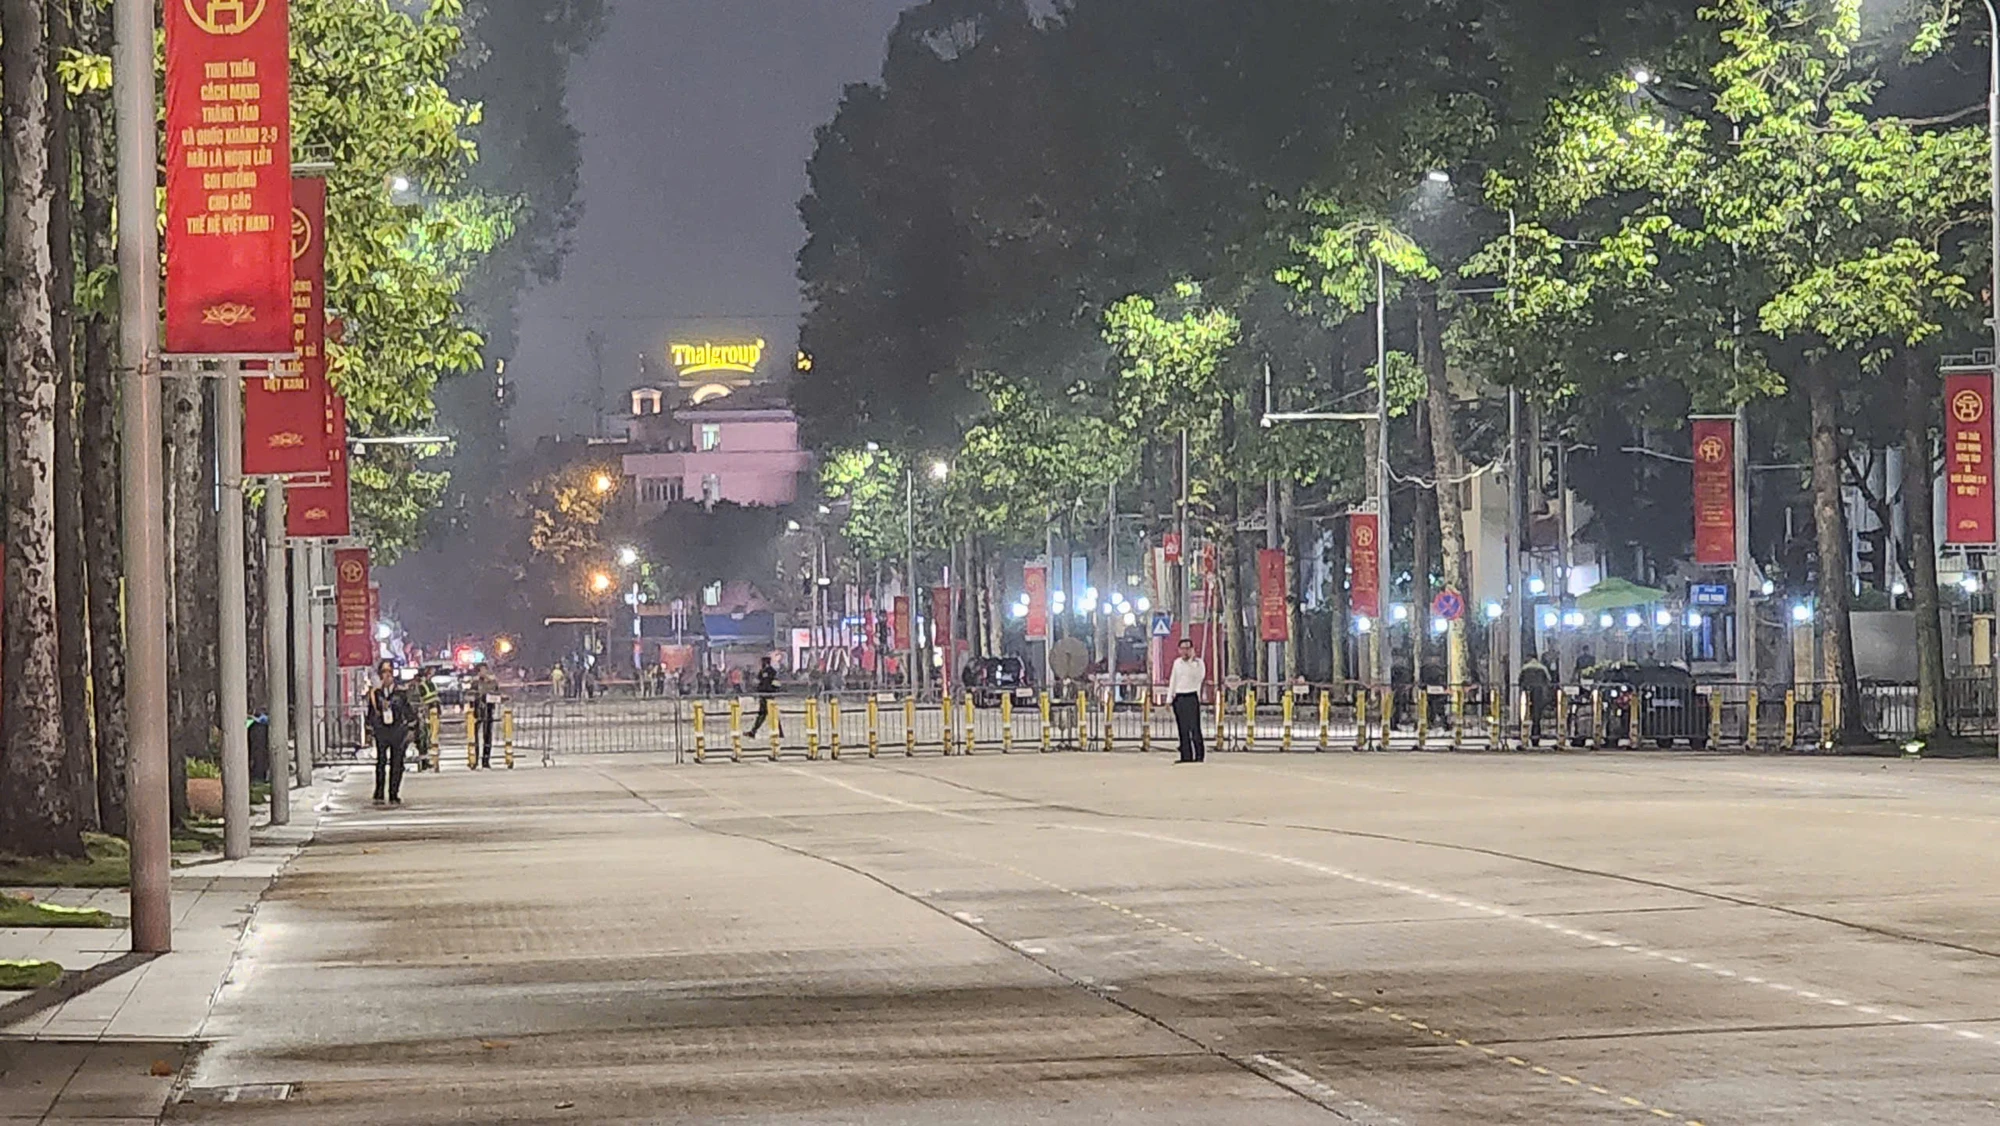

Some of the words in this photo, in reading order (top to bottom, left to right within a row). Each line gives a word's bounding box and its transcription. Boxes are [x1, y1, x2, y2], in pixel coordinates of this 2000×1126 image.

[205, 61, 227, 79] TINH
[201, 81, 228, 101] CÁCH
[229, 83, 260, 103] MẠNG
[202, 104, 234, 123] THÁNG
[235, 102, 259, 122] TÁM
[182, 126, 195, 146] VÀ
[196, 125, 224, 146] QUỐC
[225, 125, 259, 144] KHÁNH
[260, 126, 279, 144] 2-9
[209, 147, 223, 168] LÀ
[203, 172, 221, 190] SOI
[208, 194, 229, 212] CHO
[230, 191, 252, 211] CÁC
[186, 214, 205, 234] THẾ
[207, 214, 221, 236] HỆ
[222, 213, 244, 236] VIỆT
[245, 214, 270, 232] NAM
